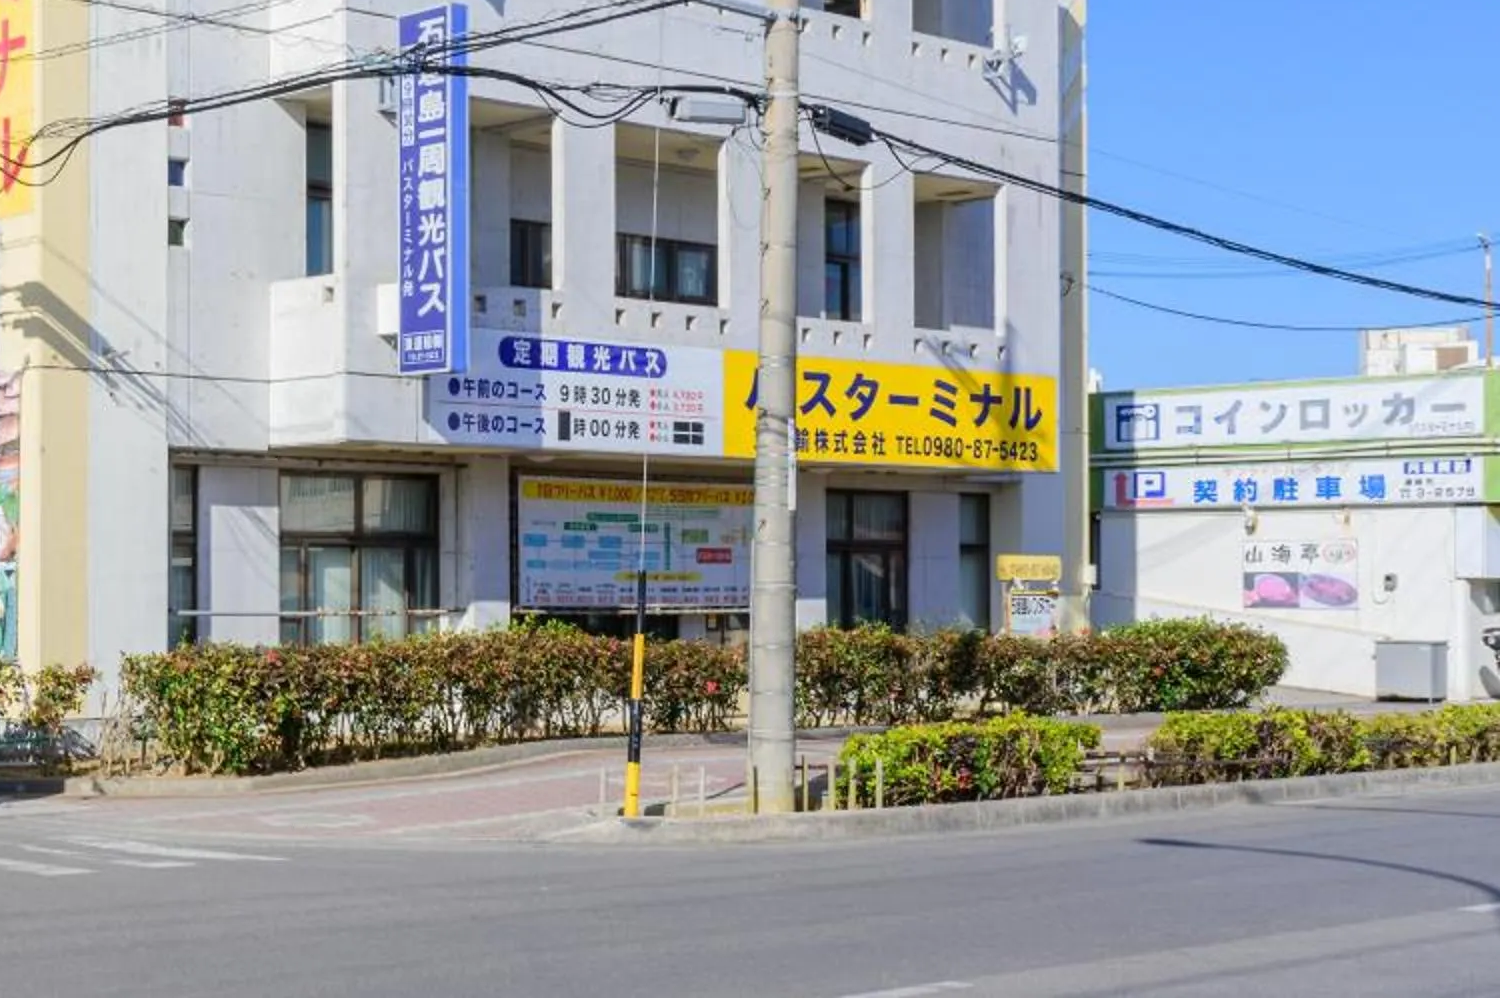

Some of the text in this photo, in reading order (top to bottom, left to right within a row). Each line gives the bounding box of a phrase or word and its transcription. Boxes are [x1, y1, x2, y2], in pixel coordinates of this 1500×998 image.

[512, 339, 662, 375] 定期観光バス
[463, 377, 548, 401] 午前のコース
[463, 411, 548, 435] 午後のコース
[1175, 392, 1467, 436] コインロッカー
[1193, 474, 1387, 503] 契約駐車場
